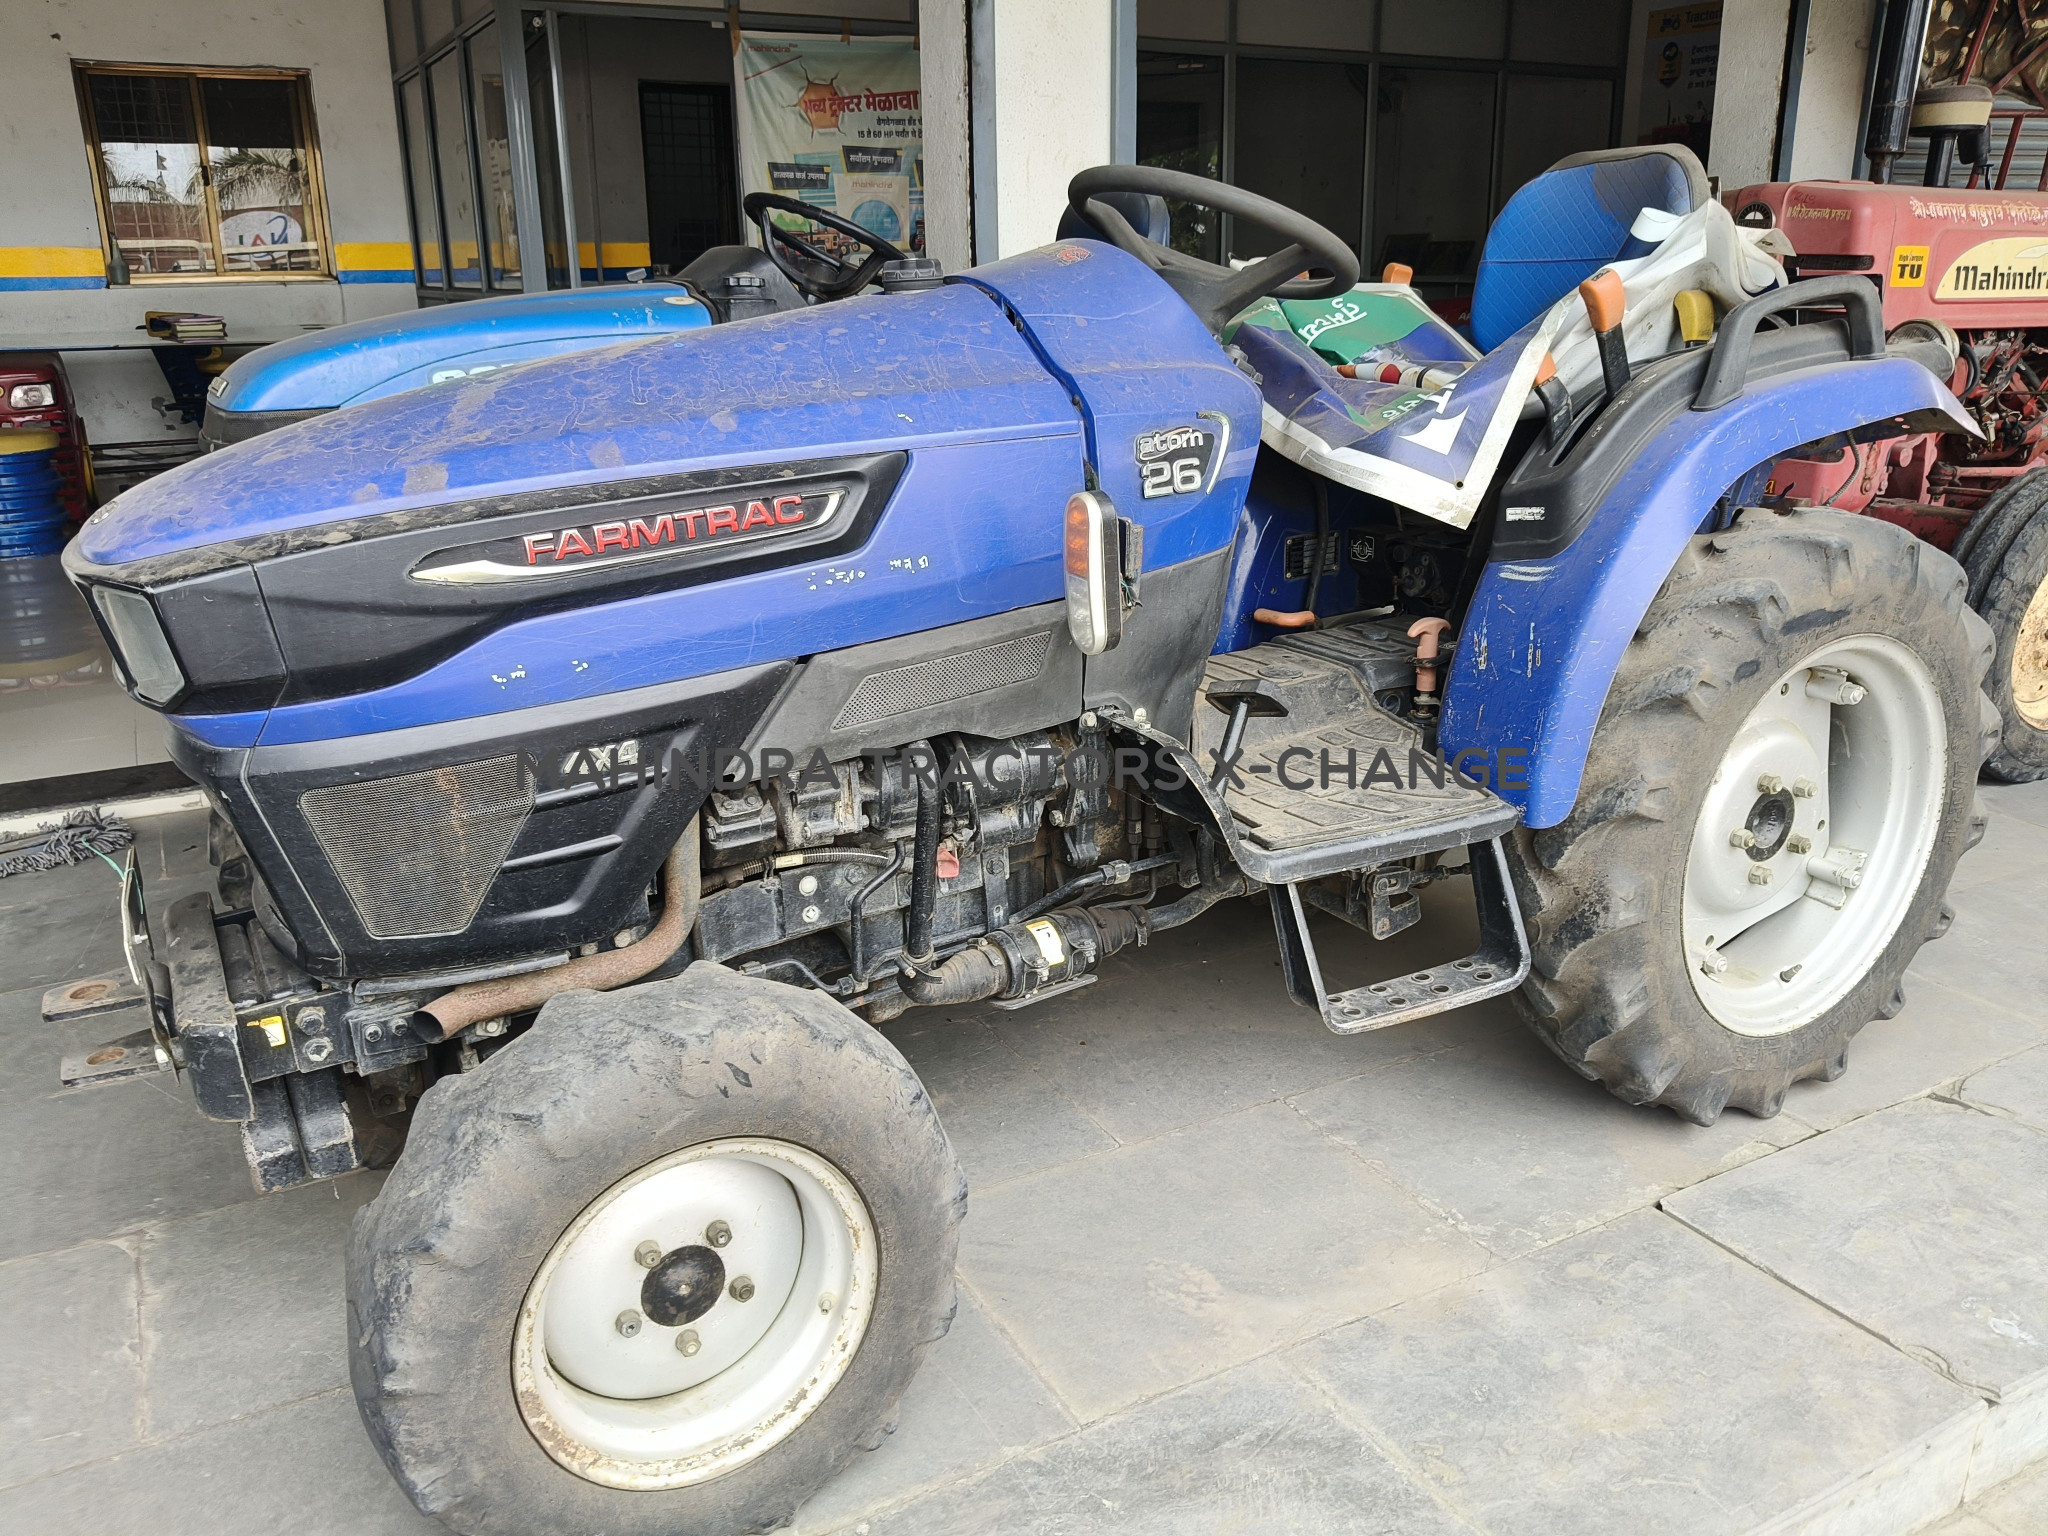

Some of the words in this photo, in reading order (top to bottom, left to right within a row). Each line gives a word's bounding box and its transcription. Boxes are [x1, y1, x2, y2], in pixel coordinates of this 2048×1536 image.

[803, 98, 826, 114] भव्य
[828, 91, 862, 117] ट्रॅक्टर
[864, 88, 919, 112] मेळावा
[858, 130, 866, 138] 15
[873, 130, 882, 138] 60
[884, 130, 894, 138] HP
[852, 181, 893, 189] mahindra
[1897, 264, 1922, 279] TU
[1954, 266, 2048, 291] Mahindr
[1139, 429, 1204, 453] atom
[1142, 457, 1202, 499] 26
[523, 495, 805, 565] FARMTRAC
